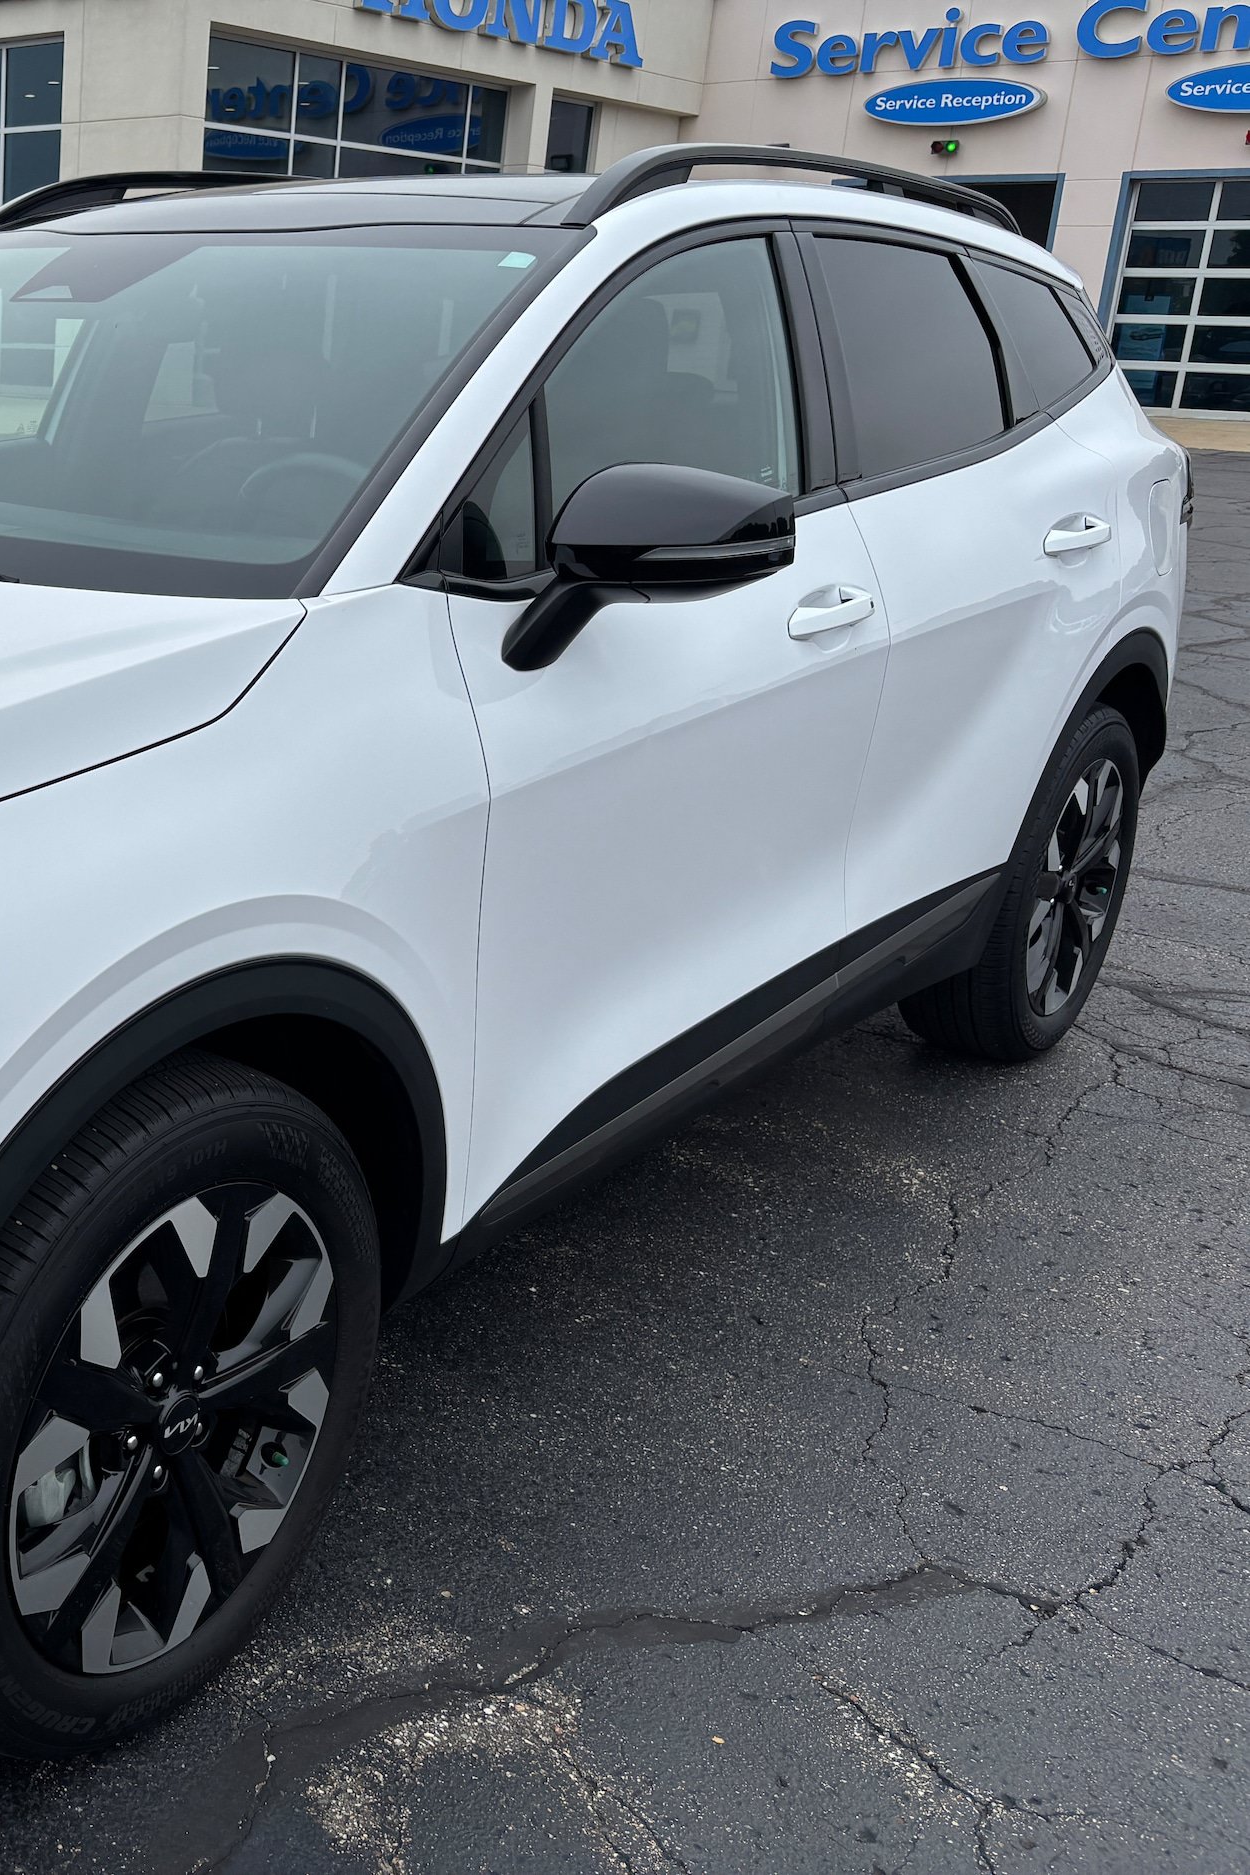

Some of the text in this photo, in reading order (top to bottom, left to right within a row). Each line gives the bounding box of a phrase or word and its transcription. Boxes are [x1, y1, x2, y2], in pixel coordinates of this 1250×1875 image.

[769, 7, 1048, 78] Service
[875, 91, 1027, 111] Service Reception
[163, 1412, 199, 1439] KIA
